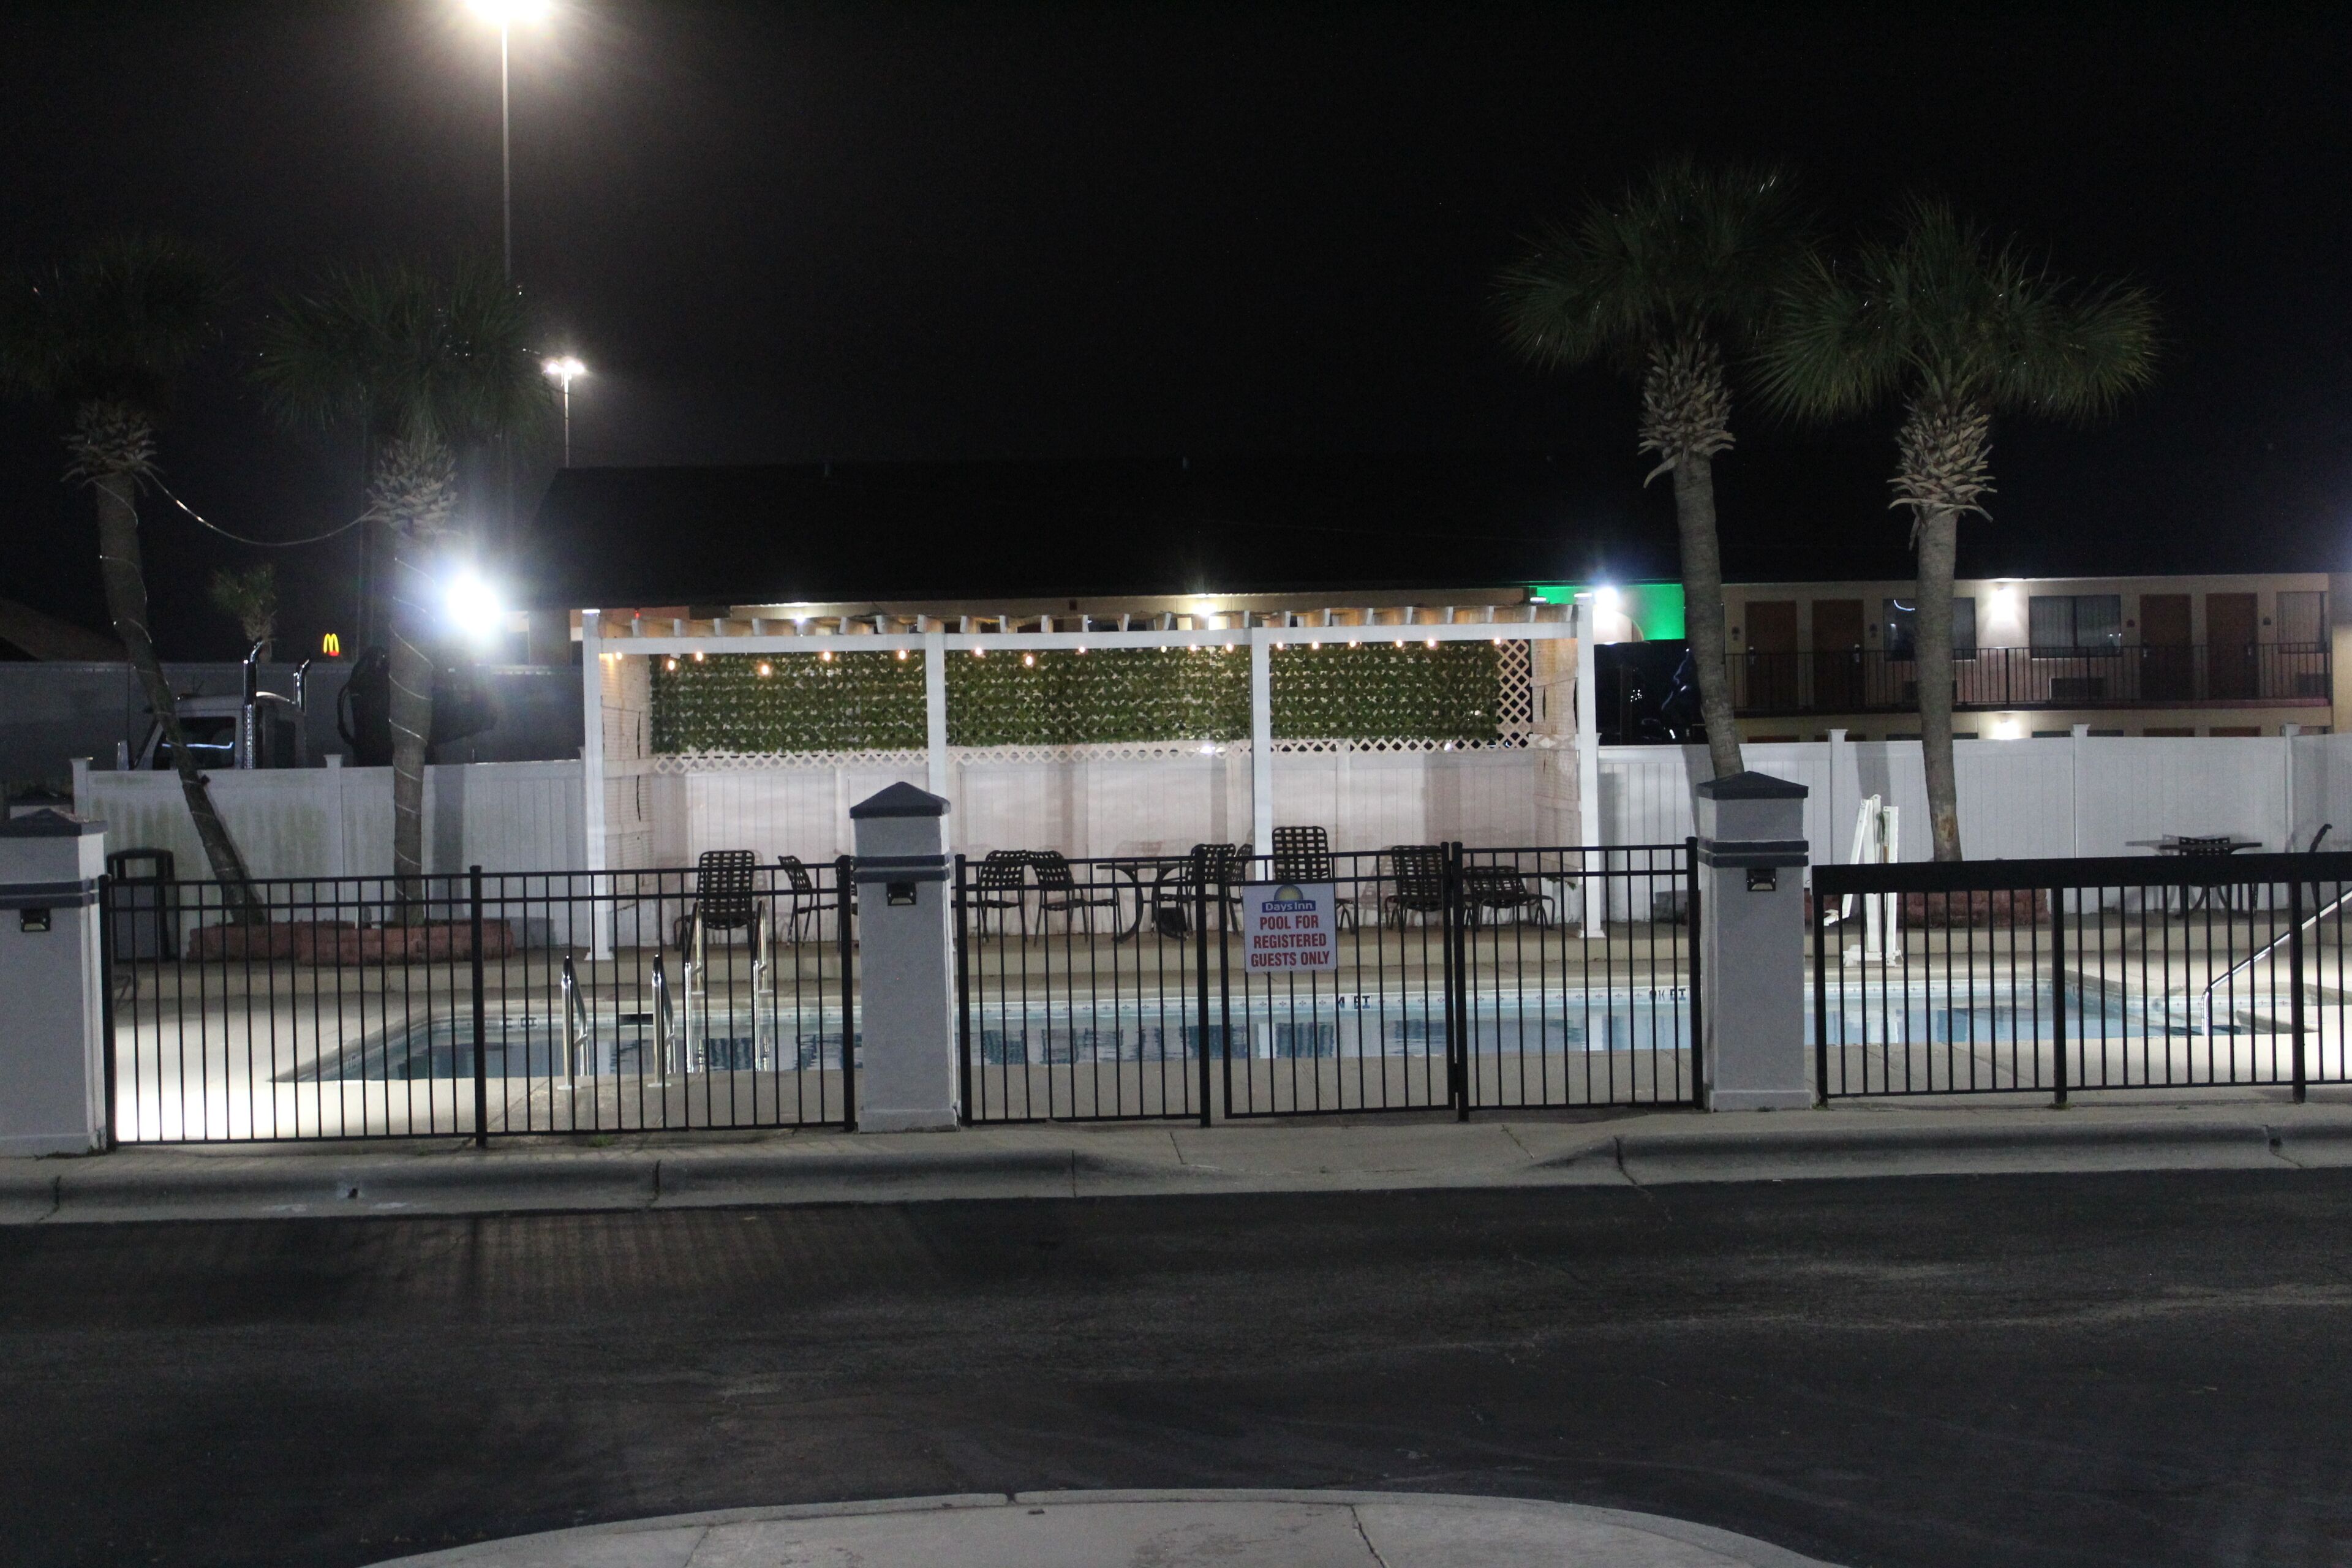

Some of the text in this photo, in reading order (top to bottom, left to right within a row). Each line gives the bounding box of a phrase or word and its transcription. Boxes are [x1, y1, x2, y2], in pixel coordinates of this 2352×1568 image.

[1265, 902, 1313, 911] Days Inn
[1260, 915, 1319, 930] POOL FOR
[1254, 933, 1327, 948] REGISTERED
[1251, 951, 1330, 967] GUESTS ONLY
